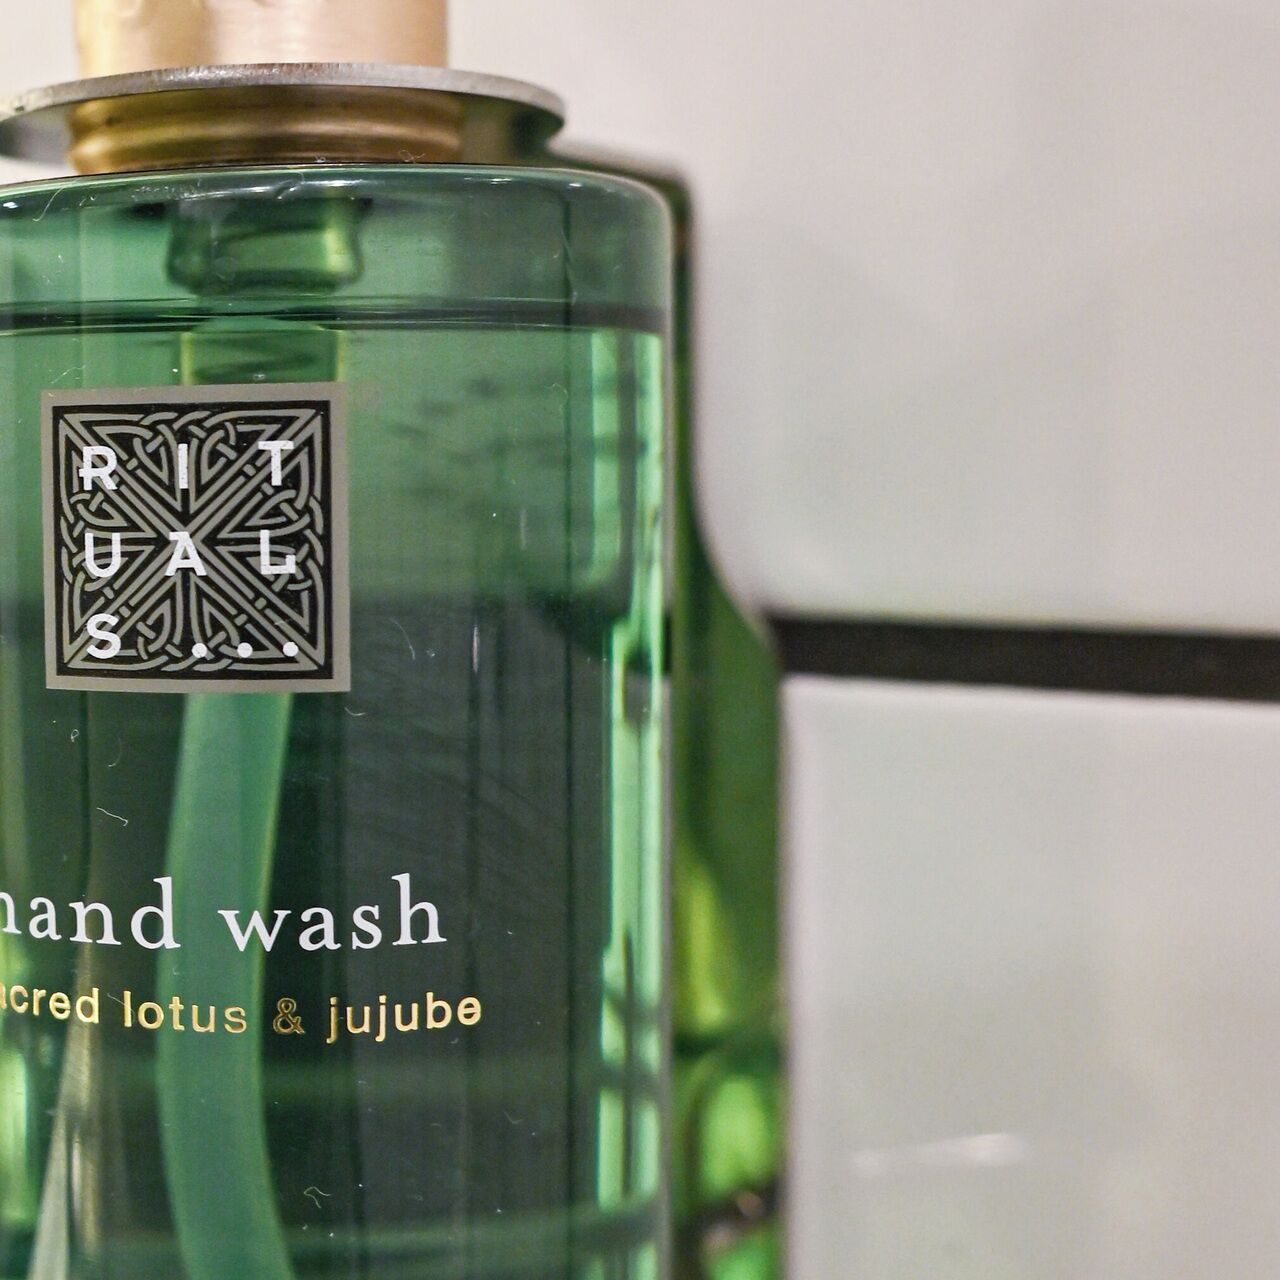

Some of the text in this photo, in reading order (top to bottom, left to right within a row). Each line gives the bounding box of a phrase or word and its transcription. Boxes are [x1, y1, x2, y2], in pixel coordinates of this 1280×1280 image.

[217, 872, 448, 953] wash
[122, 990, 248, 1034] lotus
[272, 996, 306, 1036] &
[325, 990, 483, 1045] jujube
